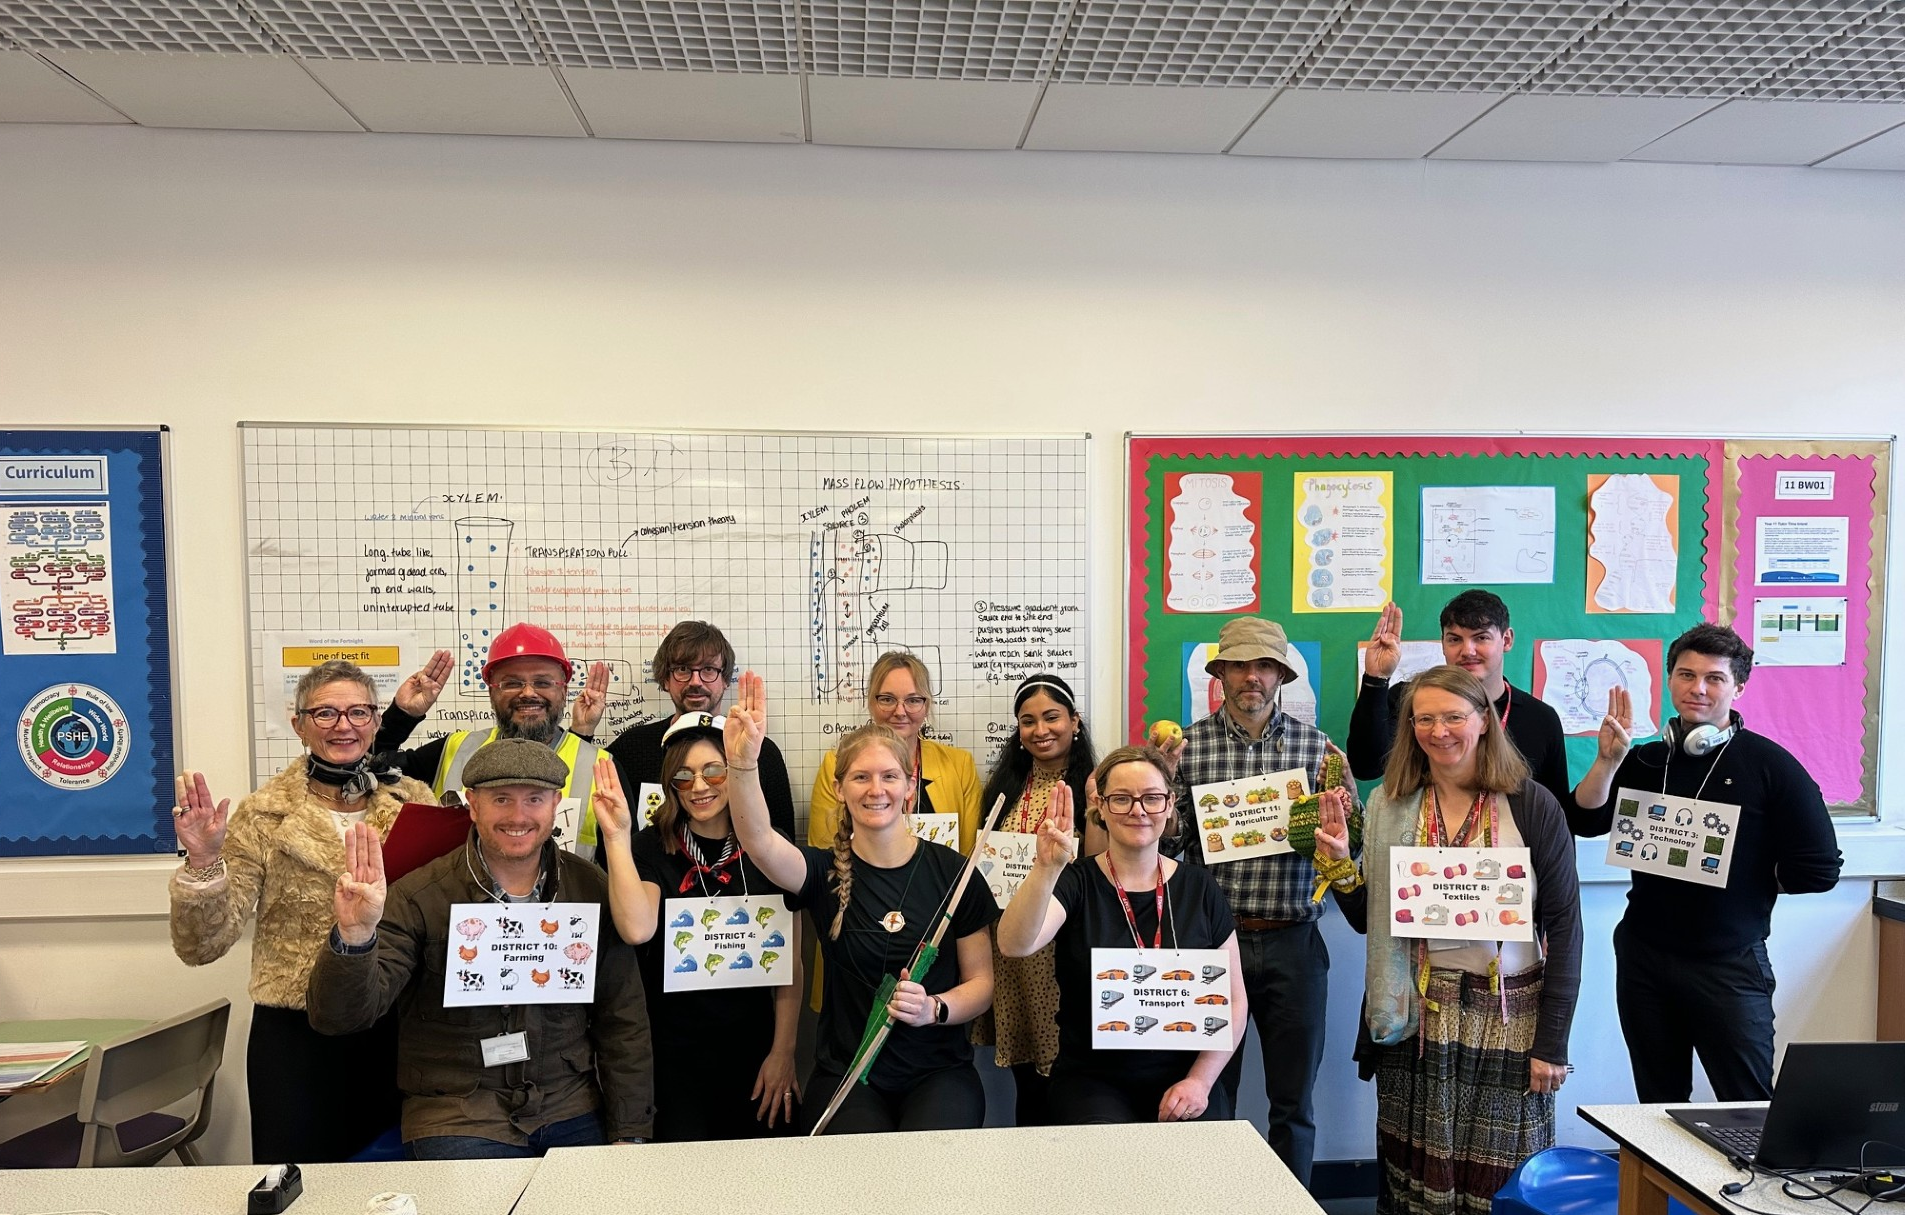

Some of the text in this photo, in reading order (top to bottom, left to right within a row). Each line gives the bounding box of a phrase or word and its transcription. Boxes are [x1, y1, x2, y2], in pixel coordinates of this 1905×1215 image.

[5, 465, 95, 479] Curriculum
[823, 477, 849, 490] MASS
[1184, 477, 1227, 489] MITOSIS
[1309, 478, 1373, 498] Phagocytosis
[1785, 481, 1825, 490] 11 BW01
[708, 514, 736, 527] theory
[391, 545, 411, 557] tube
[525, 546, 605, 558] TRANSPIRATION
[407, 567, 427, 577] dead
[370, 586, 380, 594] no
[386, 584, 403, 594] end
[433, 602, 455, 612] tube
[990, 602, 1021, 612] Pressure
[1025, 602, 1058, 615] gradient
[1060, 605, 1079, 615] from
[977, 626, 1002, 636] pushes
[1032, 626, 1053, 636] along
[312, 652, 370, 660] Line of best fit
[999, 649, 1020, 658] reach
[30, 691, 60, 713] Democracy
[86, 691, 114, 713] Rule of law
[37, 728, 45, 748] Health
[42, 704, 69, 723] Wellbeing
[88, 708, 109, 742] Wider World
[999, 723, 1006, 731] at
[57, 731, 90, 741] PSHE
[106, 728, 124, 771] Individual liberty
[25, 748, 42, 771] respect
[51, 758, 95, 770] Relationships
[59, 777, 90, 785] Tolerance
[1229, 806, 1267, 819] DISTRICT
[1235, 814, 1279, 827] Agriculture
[1649, 825, 1699, 839] DISTRICT 3:
[1649, 833, 1696, 848] Technology
[1005, 862, 1034, 871] DISTRIC
[1003, 871, 1027, 879] Luxury
[1432, 883, 1490, 891] DISTRICT 8:
[1442, 892, 1480, 901] Textiles
[704, 932, 746, 941] DISTRICT
[491, 943, 540, 952] DISTRICT
[714, 942, 746, 950] Fishing
[503, 953, 545, 963] Farming
[1133, 988, 1190, 997] DISTRICT 6:
[1139, 999, 1185, 1008] Transport
[1869, 1101, 1899, 1112] stone
